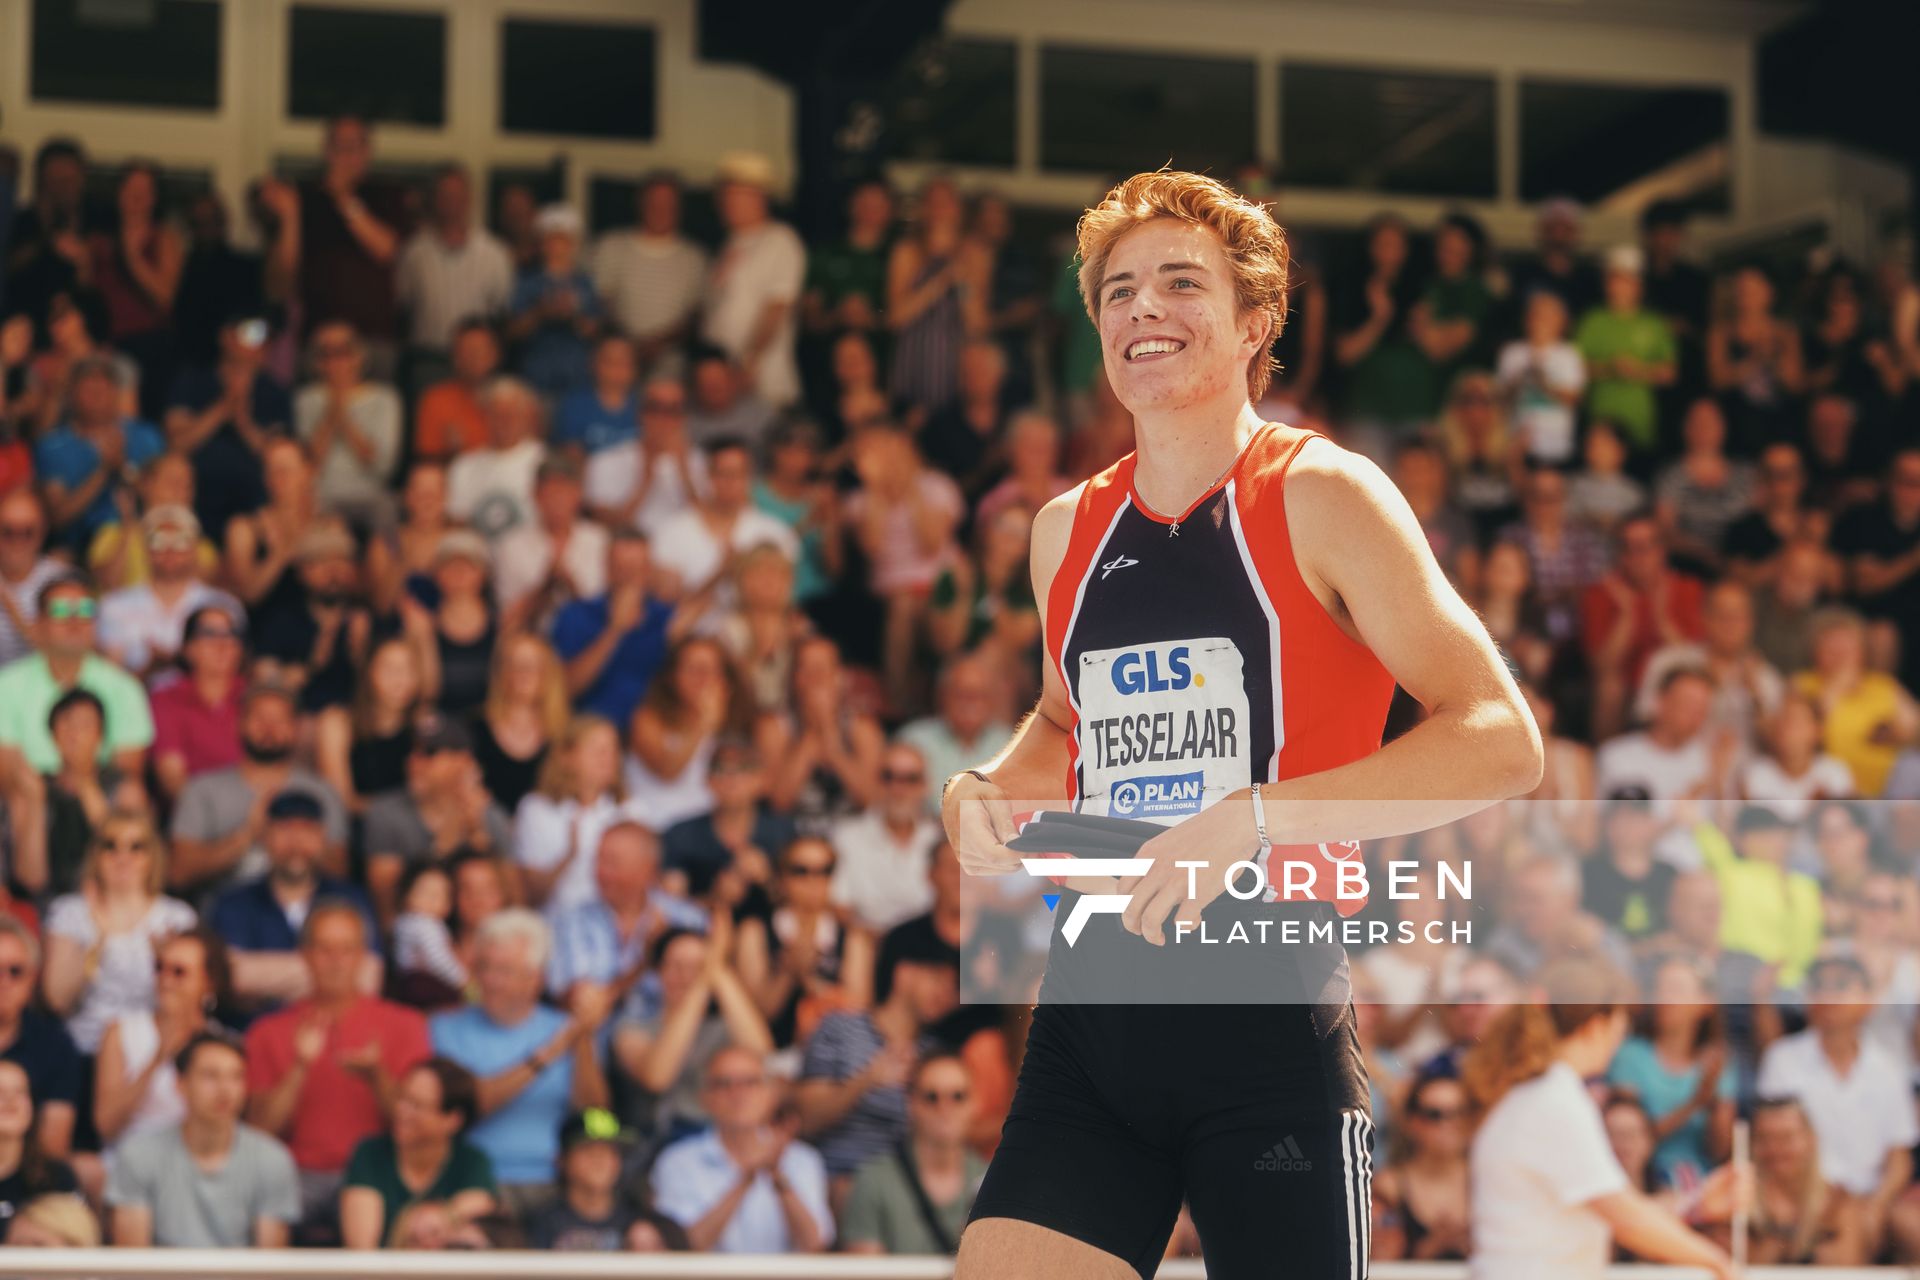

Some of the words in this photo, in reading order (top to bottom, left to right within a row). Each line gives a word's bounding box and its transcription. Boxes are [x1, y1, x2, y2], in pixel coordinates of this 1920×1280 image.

[1090, 707, 1237, 769] TESSELAAR
[1144, 780, 1199, 801] PLAN
[1143, 801, 1197, 812] INTERNATIONAL
[1254, 1157, 1312, 1171] adidas
